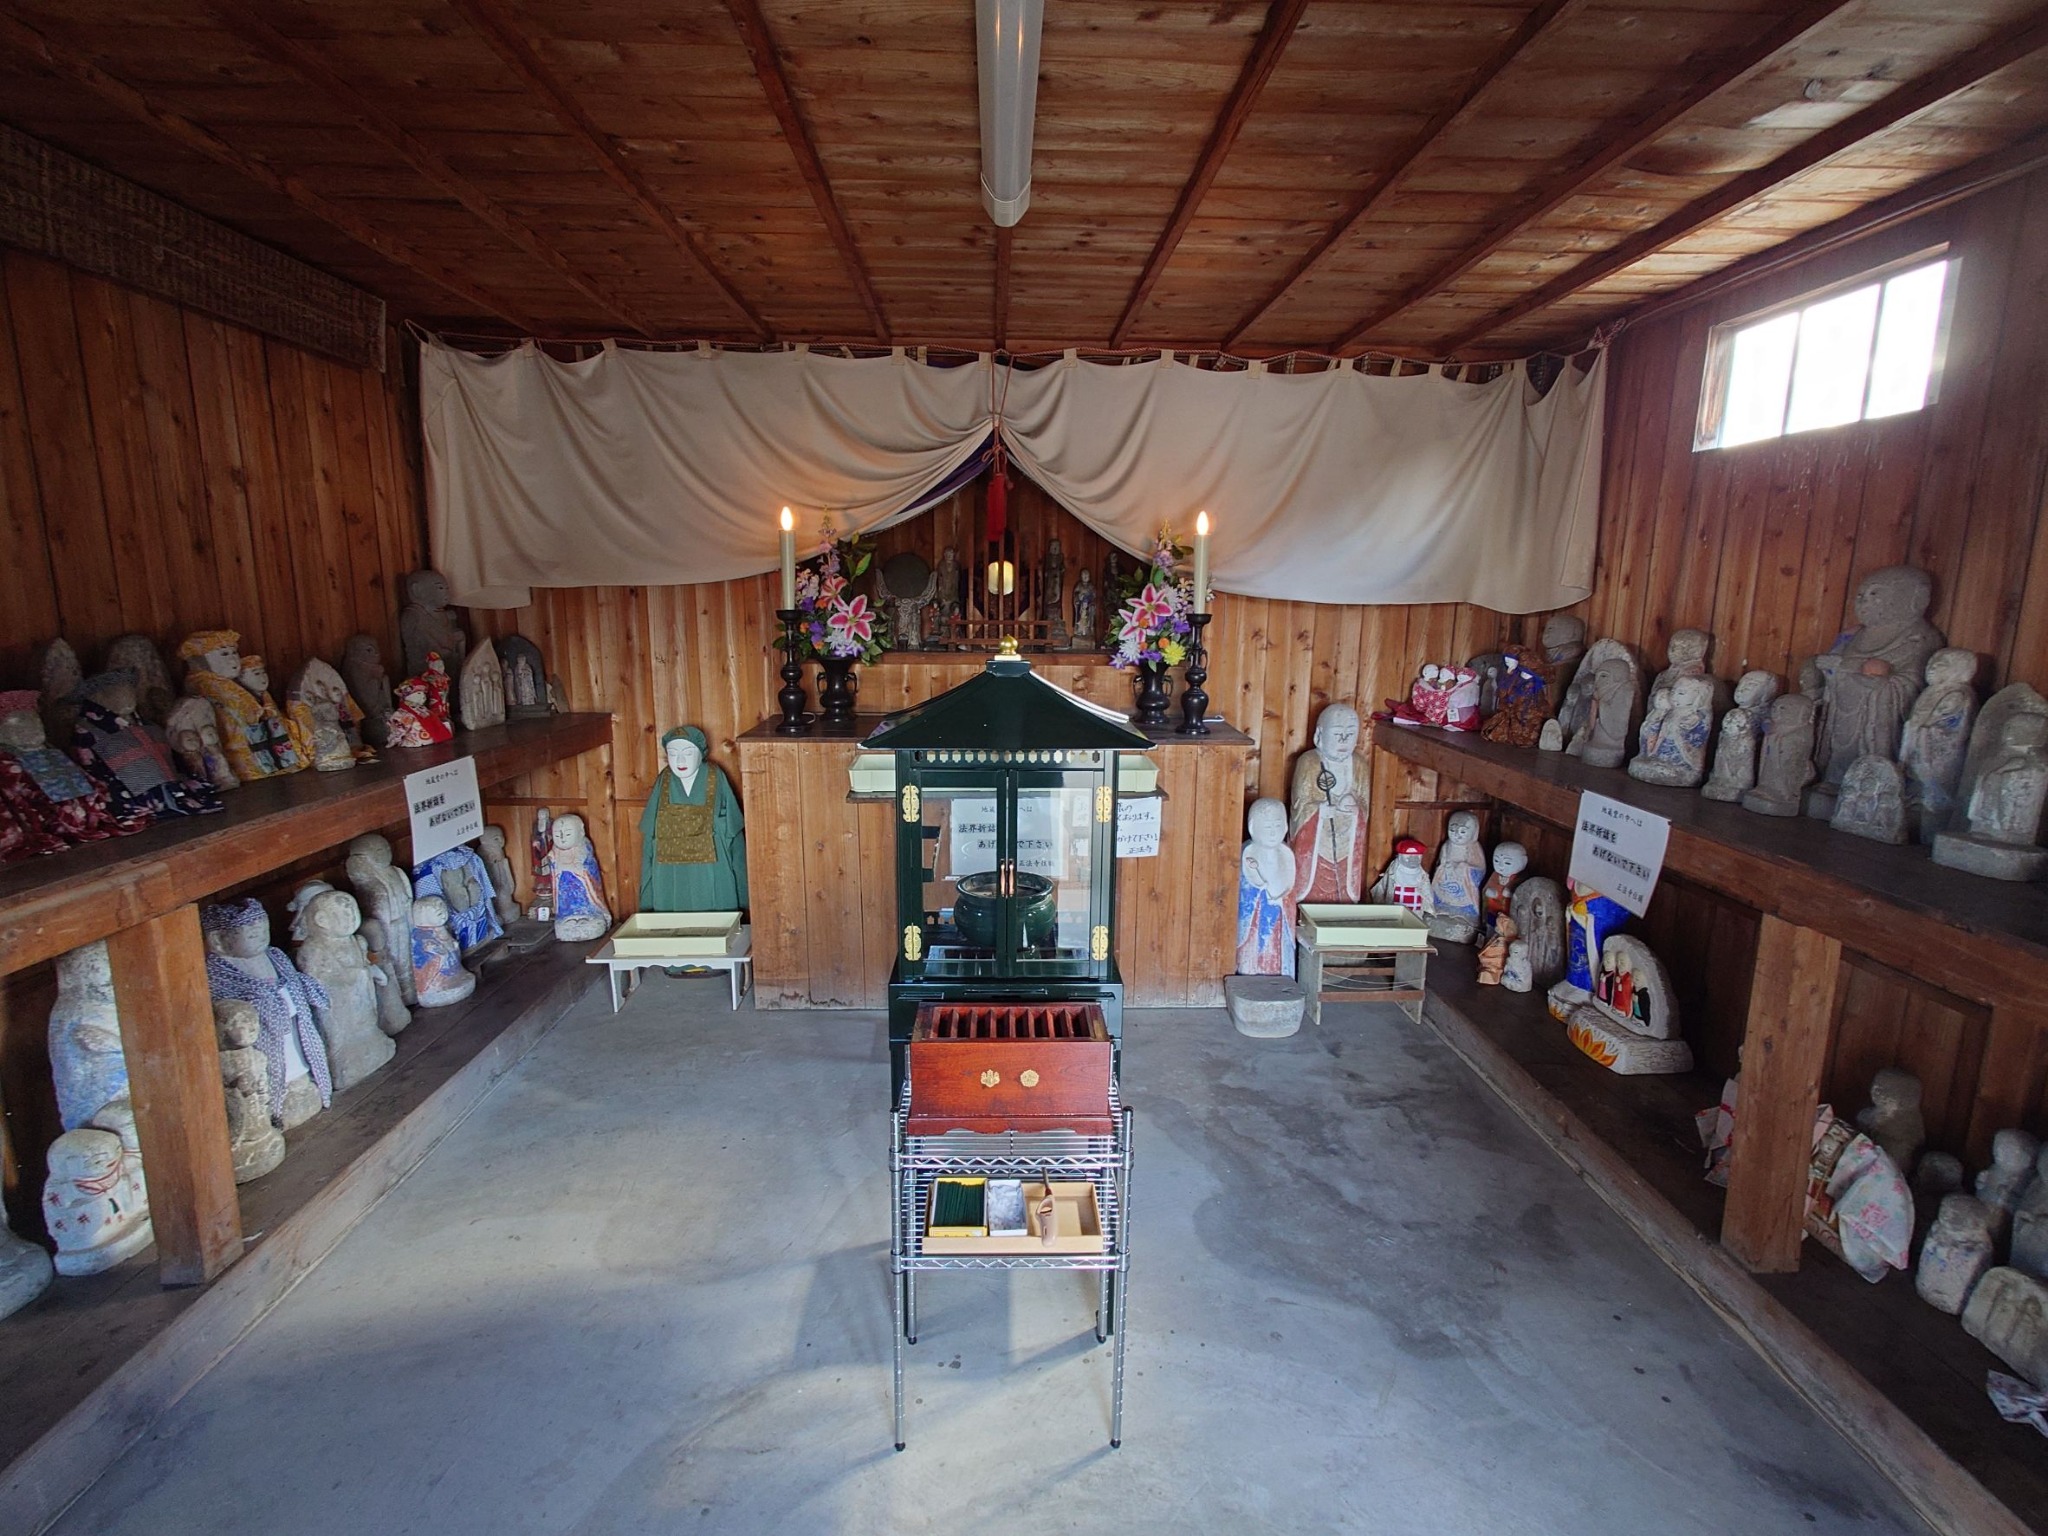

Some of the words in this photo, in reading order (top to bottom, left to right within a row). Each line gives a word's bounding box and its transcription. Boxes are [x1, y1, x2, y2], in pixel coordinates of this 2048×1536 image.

[958, 824, 996, 834] 法界折詰
[1592, 846, 1650, 878] あげないで下さい
